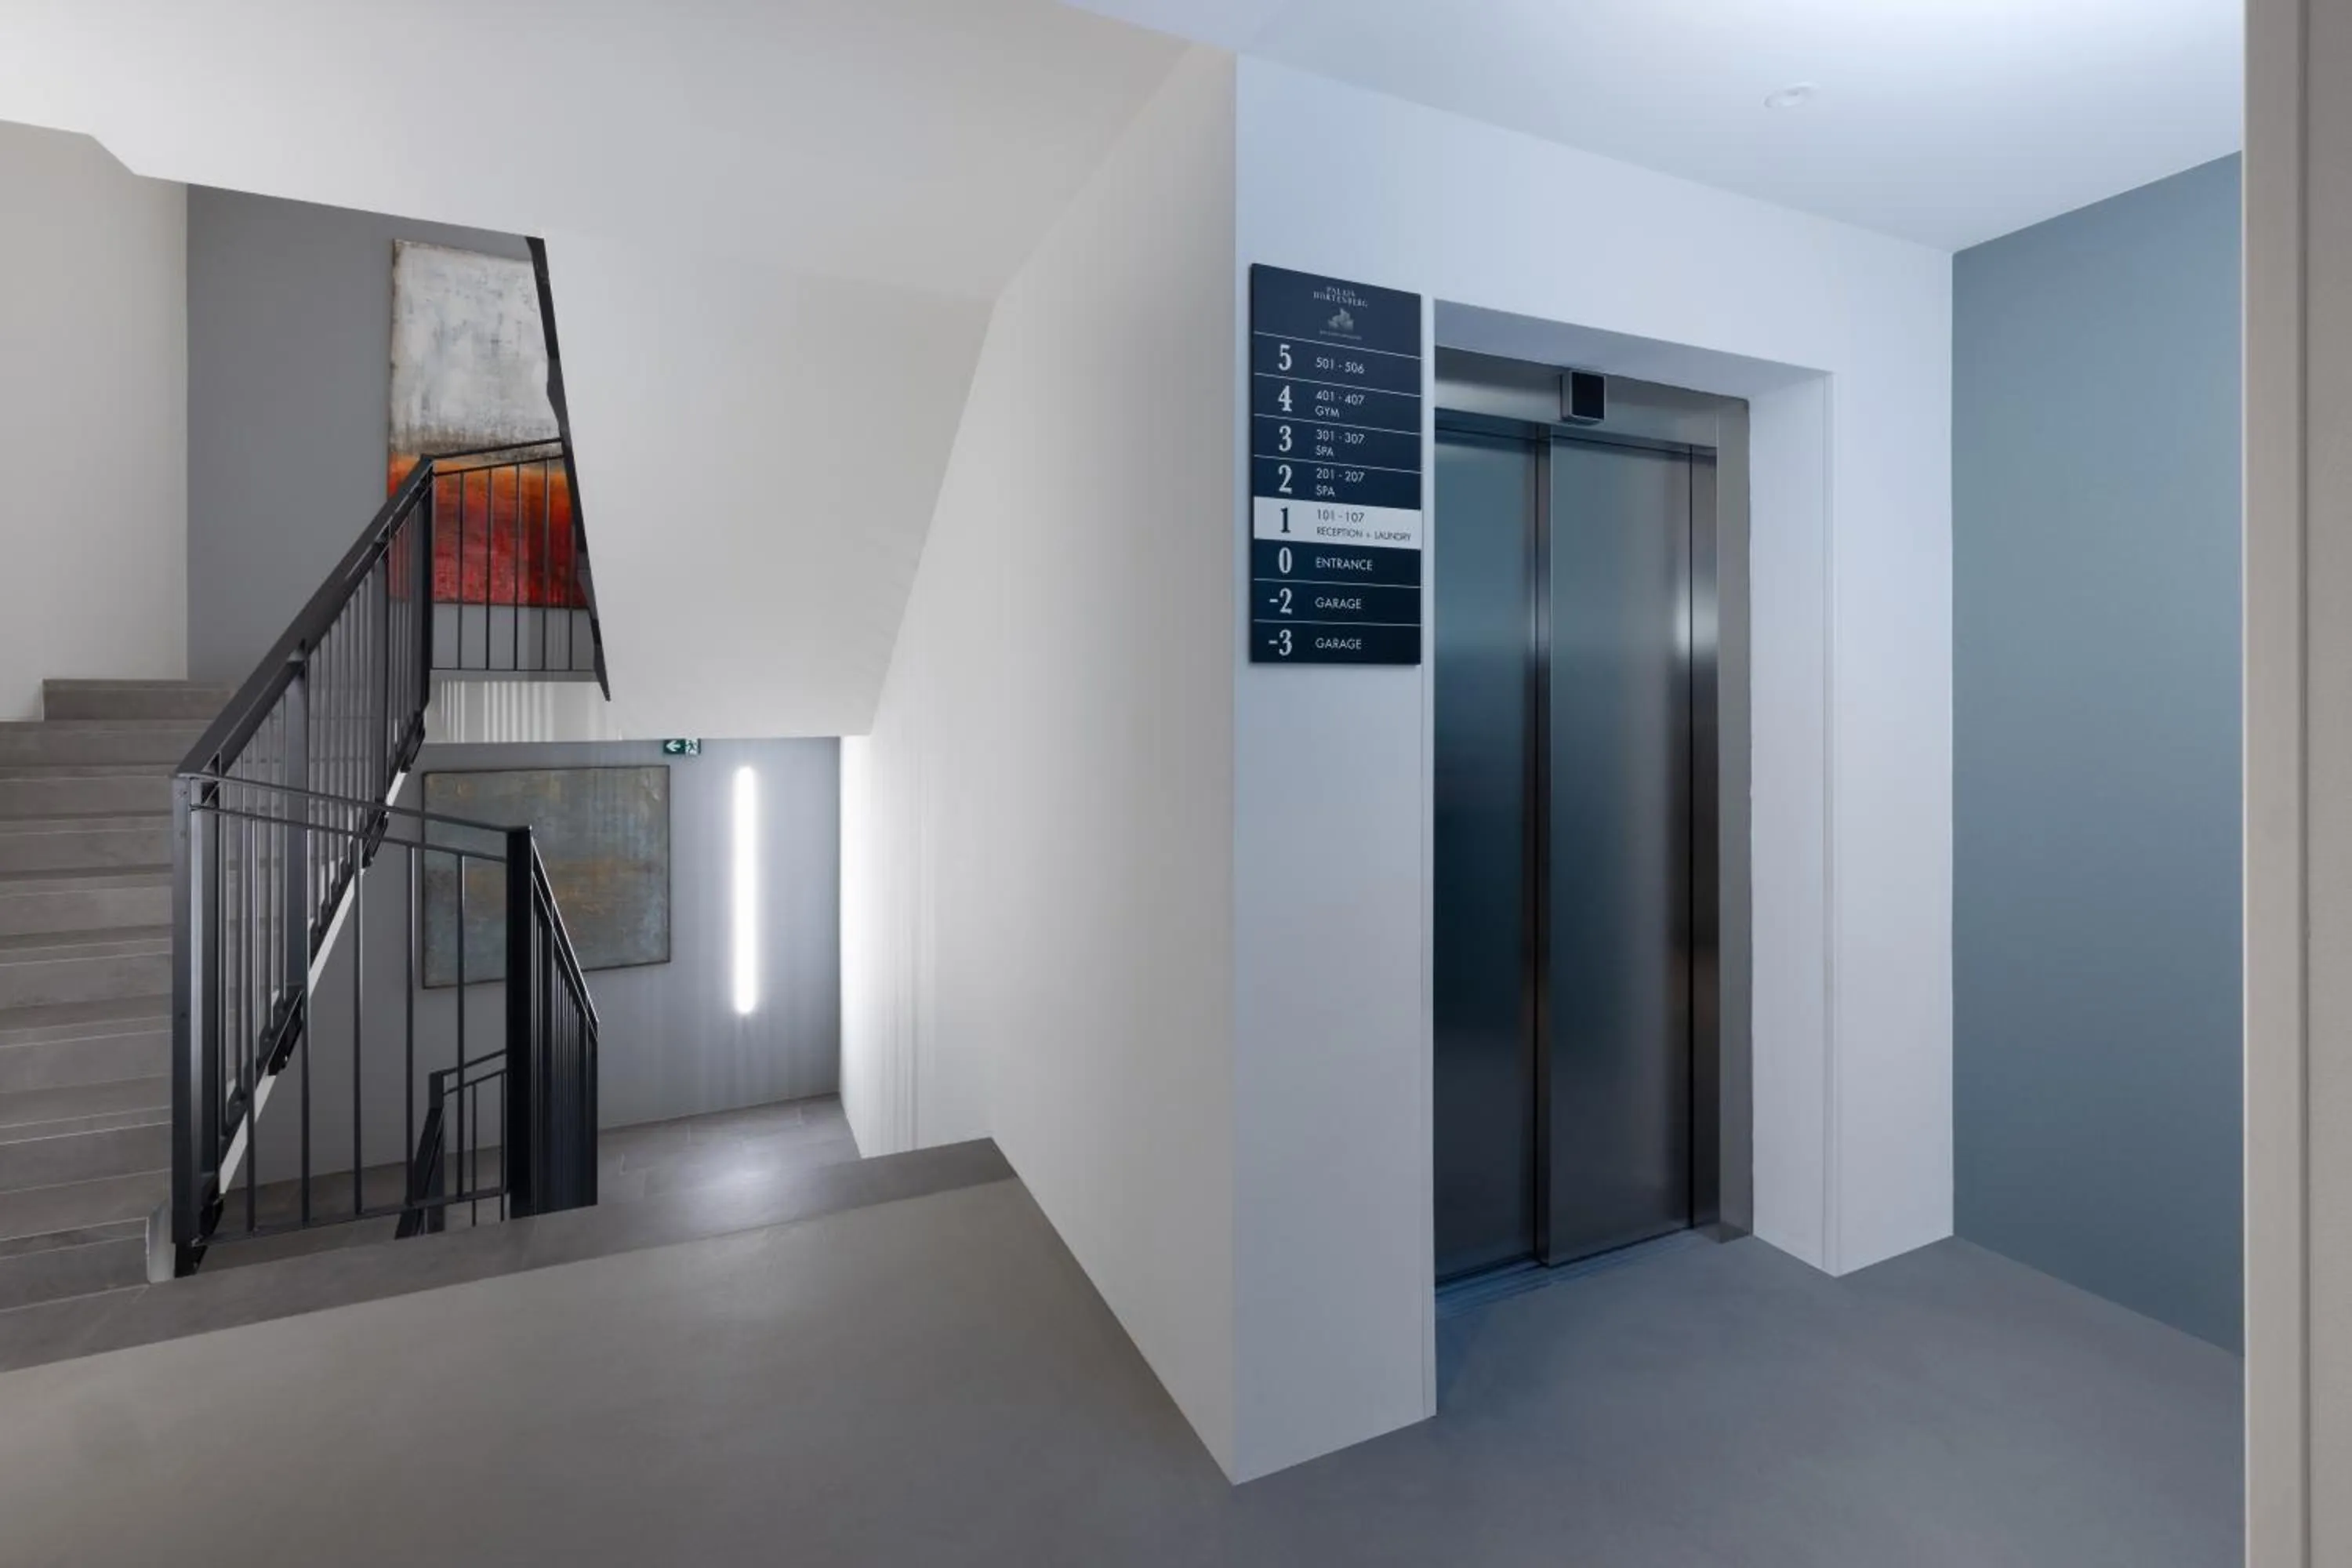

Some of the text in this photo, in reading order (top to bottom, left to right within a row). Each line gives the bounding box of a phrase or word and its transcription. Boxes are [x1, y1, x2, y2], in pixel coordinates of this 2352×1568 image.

[1278, 343, 1292, 371] 5
[1316, 356, 1334, 370] 501
[1345, 361, 1365, 375] 506
[1278, 385, 1293, 412] 4
[1316, 390, 1334, 401] 401
[1344, 394, 1365, 405] 407
[1315, 405, 1340, 418] GYM
[1279, 425, 1293, 452] 3
[1316, 429, 1334, 441] 301
[1345, 432, 1365, 445] 307
[1315, 445, 1334, 456] SPA
[1278, 464, 1293, 494] 2
[1316, 466, 1334, 480] 201
[1345, 470, 1365, 483] 207
[1316, 484, 1335, 496] SPA
[1280, 506, 1290, 534] 1
[1316, 508, 1335, 521] 101
[1345, 511, 1365, 524] 107
[1316, 526, 1363, 539] RECEPTION
[1374, 531, 1412, 542] LAUNDRY
[1278, 546, 1293, 574] 0
[1315, 557, 1373, 572] ENTRANCE
[1269, 587, 1293, 615] -2
[1314, 597, 1362, 610] GARAGE
[1269, 629, 1293, 656] -3
[1315, 637, 1362, 650] GARAGE
